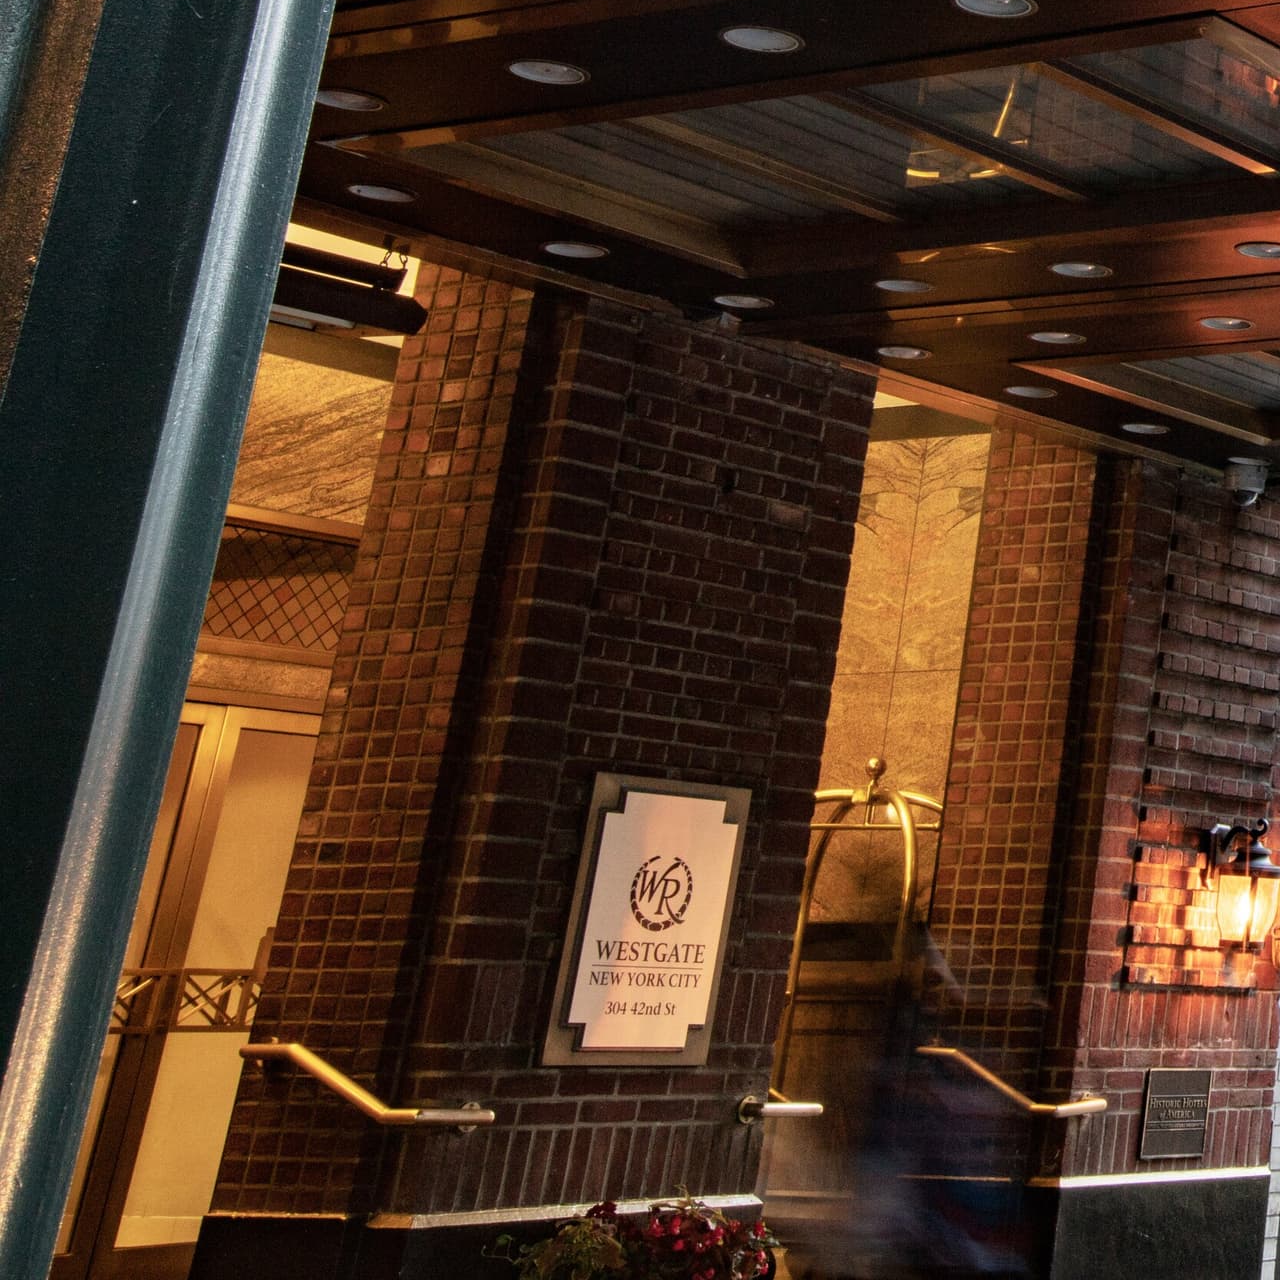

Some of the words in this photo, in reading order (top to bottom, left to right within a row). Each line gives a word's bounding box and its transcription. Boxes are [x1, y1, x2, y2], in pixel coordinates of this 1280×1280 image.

[638, 862, 686, 925] WR
[596, 940, 706, 964] WESTGATE
[589, 971, 624, 986] NEW
[627, 972, 668, 988] YORK
[668, 973, 702, 989] CITY
[605, 1001, 627, 1016] 304
[630, 1002, 662, 1016] 42nd
[664, 1002, 676, 1016] St
